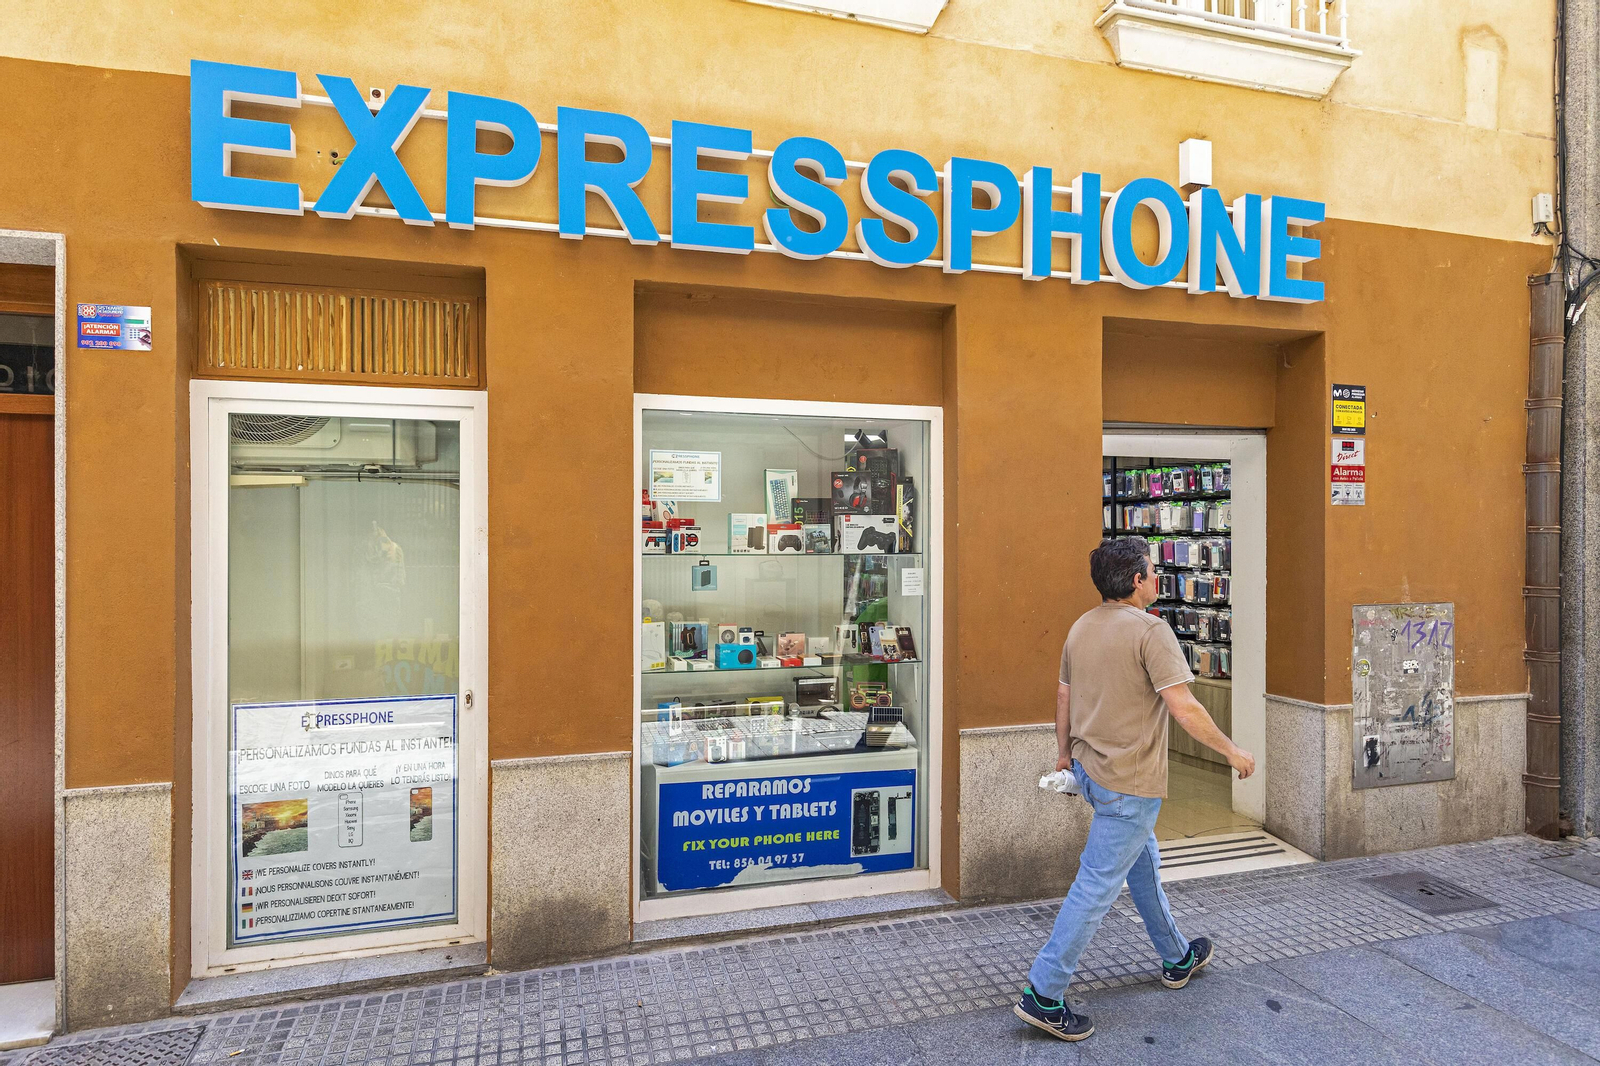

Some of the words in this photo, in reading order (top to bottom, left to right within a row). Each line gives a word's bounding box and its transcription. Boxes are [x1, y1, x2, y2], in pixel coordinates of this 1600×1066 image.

[189, 59, 1326, 304] EXPRESSPHONE
[1333, 467, 1364, 476] Alarma
[238, 743, 336, 764] ¡PERSONALIZAMOS
[339, 740, 381, 754] FUNDAS
[385, 739, 397, 752] AL
[401, 736, 453, 751] INSTANTE!
[324, 770, 344, 779] DINOS
[345, 768, 361, 778] PARA
[363, 765, 377, 779] QUÉ
[403, 763, 413, 772] EN
[413, 762, 427, 771] UNA
[428, 761, 446, 770] HORA
[239, 784, 268, 794] ESCOGE
[270, 782, 286, 792] UNA
[288, 780, 311, 790] FOTO
[317, 782, 346, 792] MODELO
[347, 781, 357, 791] LA
[358, 779, 385, 791] QUIERES
[391, 776, 400, 785] LO
[402, 772, 430, 784] TENDRÁS
[702, 778, 811, 799] REPARAMOS
[672, 805, 748, 827] MOVILES
[753, 805, 765, 820] Y
[769, 800, 837, 819] TABLETS
[683, 839, 705, 851] FIX
[709, 836, 750, 849] YOUR
[754, 832, 802, 845] PHONE
[806, 829, 840, 841] HERE
[268, 863, 311, 876] PERSONALIZE
[312, 861, 337, 871] COVERS
[338, 858, 376, 869] INSTANTLY!
[709, 860, 730, 870] TEL:
[733, 858, 755, 868] 856
[775, 854, 788, 864] 97
[792, 853, 804, 863] 37
[277, 879, 333, 891] PERSONNALISONS
[334, 876, 359, 886] COUVRE
[361, 870, 420, 884] INSTANTANÉMENT!
[270, 896, 325, 908] PERSONALISIEREN
[326, 893, 346, 902] DECKT
[348, 890, 376, 900] SOFORT!
[317, 907, 351, 918] COPERTINE
[352, 900, 415, 914] ISTANTANEAMENTE!
